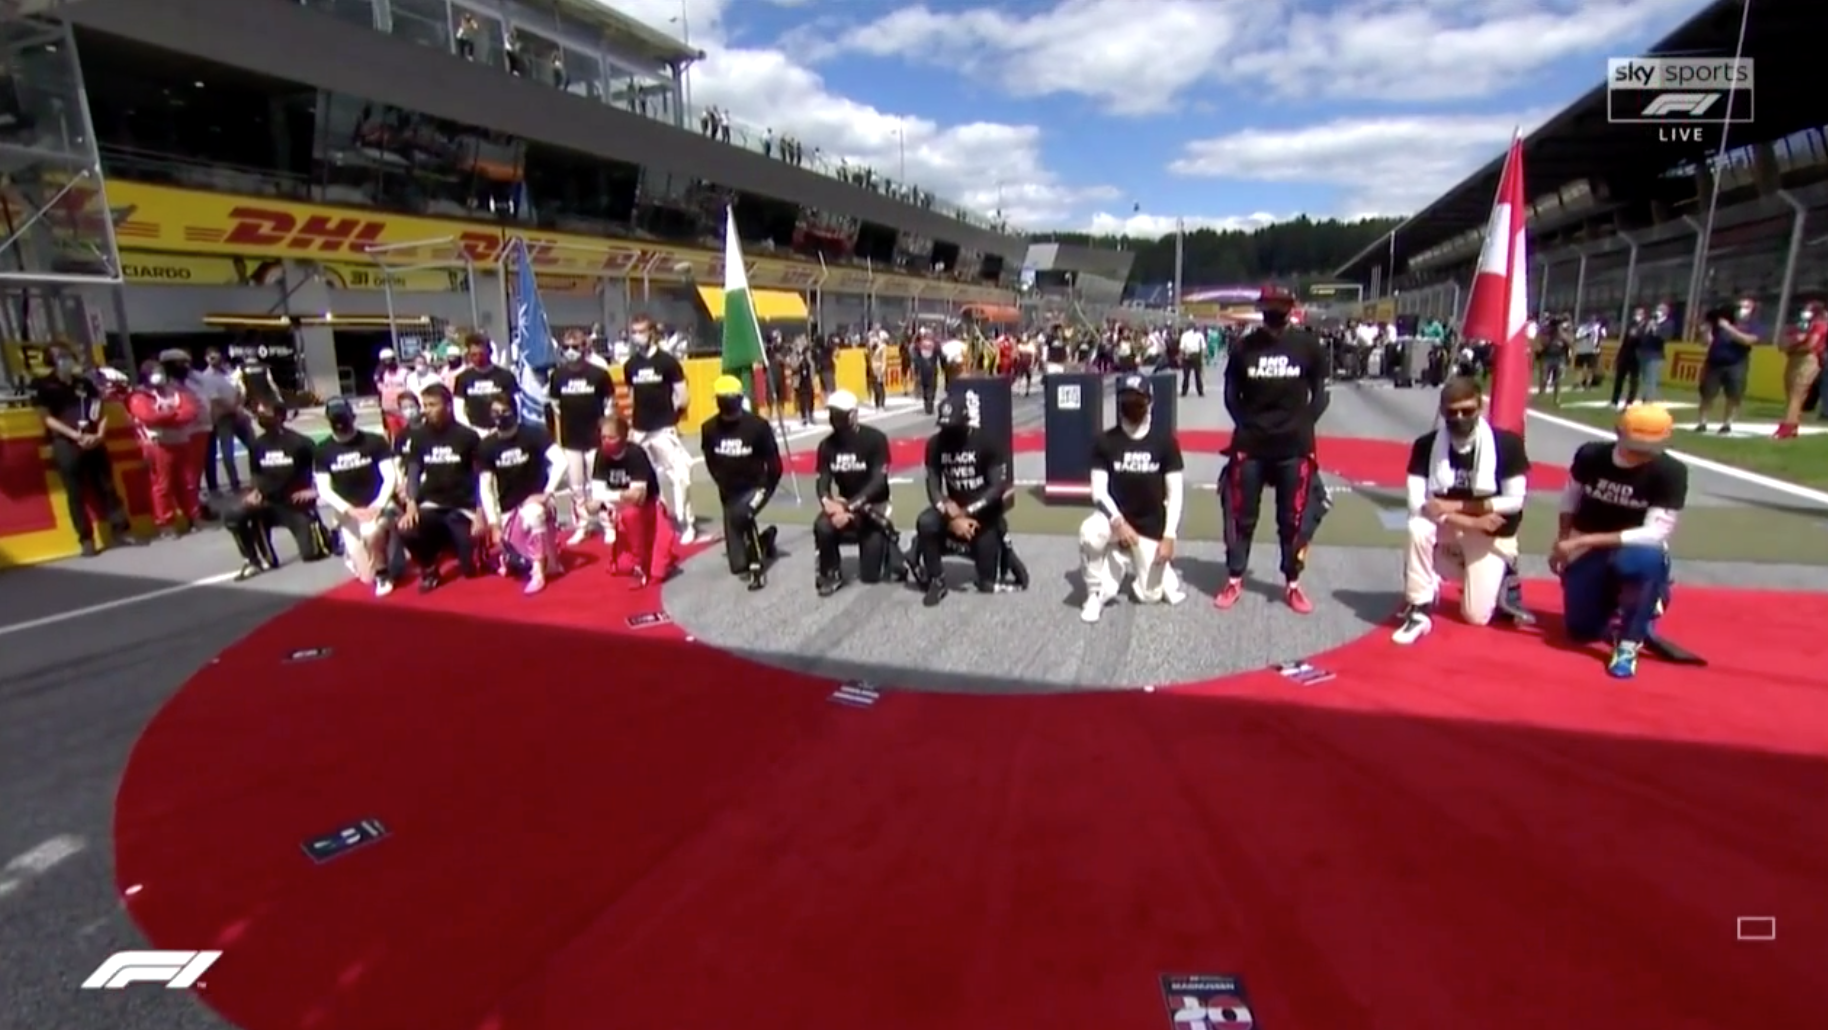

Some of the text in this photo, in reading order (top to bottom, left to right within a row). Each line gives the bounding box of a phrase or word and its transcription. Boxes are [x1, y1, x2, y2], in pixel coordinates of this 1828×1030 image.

[223, 205, 387, 254] DHL
[1259, 355, 1289, 366] END
[941, 451, 977, 464] BLACK
[1124, 451, 1152, 461] END
[1597, 478, 1634, 496] END
